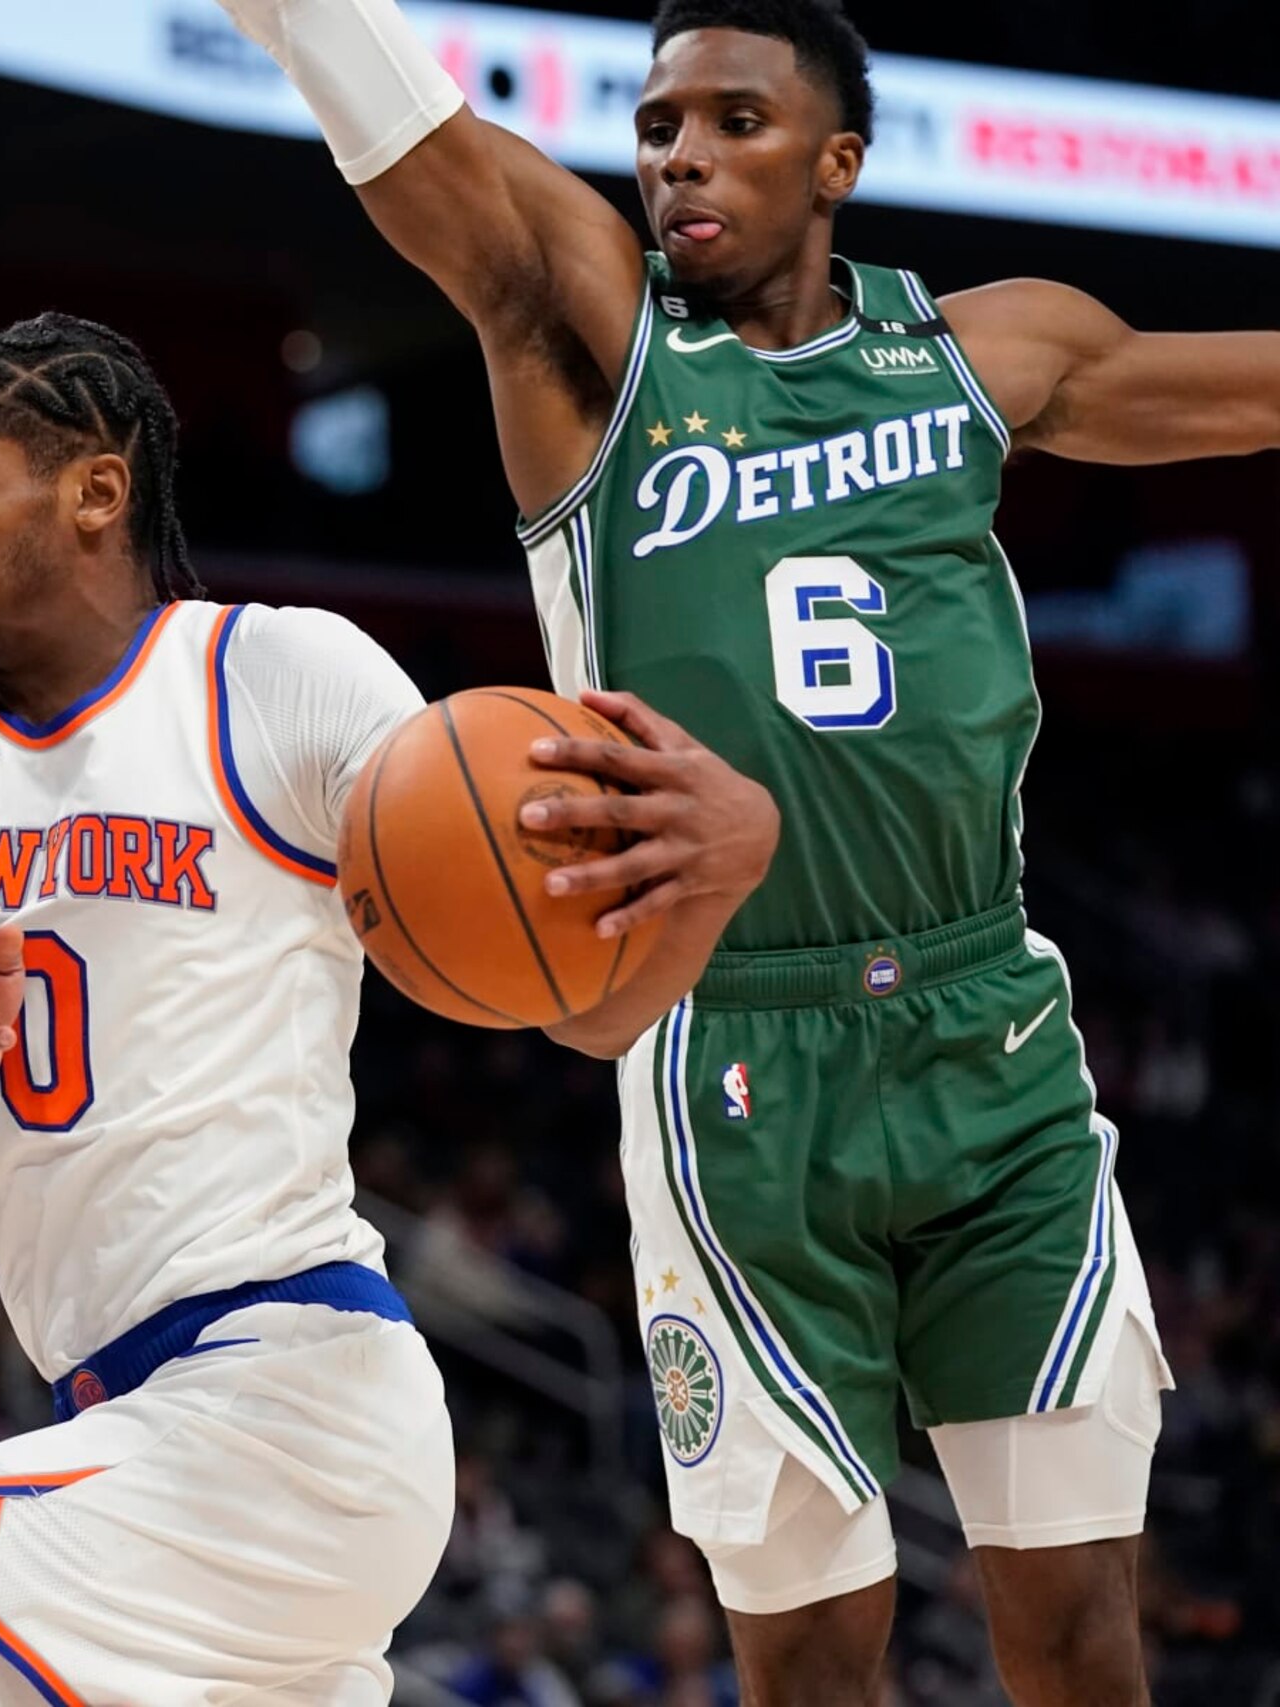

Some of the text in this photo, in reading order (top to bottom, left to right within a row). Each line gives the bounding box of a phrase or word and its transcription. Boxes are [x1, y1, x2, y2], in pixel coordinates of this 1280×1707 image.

[660, 295, 689, 319] 6
[859, 346, 936, 369] UWM
[632, 403, 971, 559] DETROIT
[765, 555, 897, 732] 6
[38, 812, 219, 913] YORK
[0, 930, 95, 1133] 0
